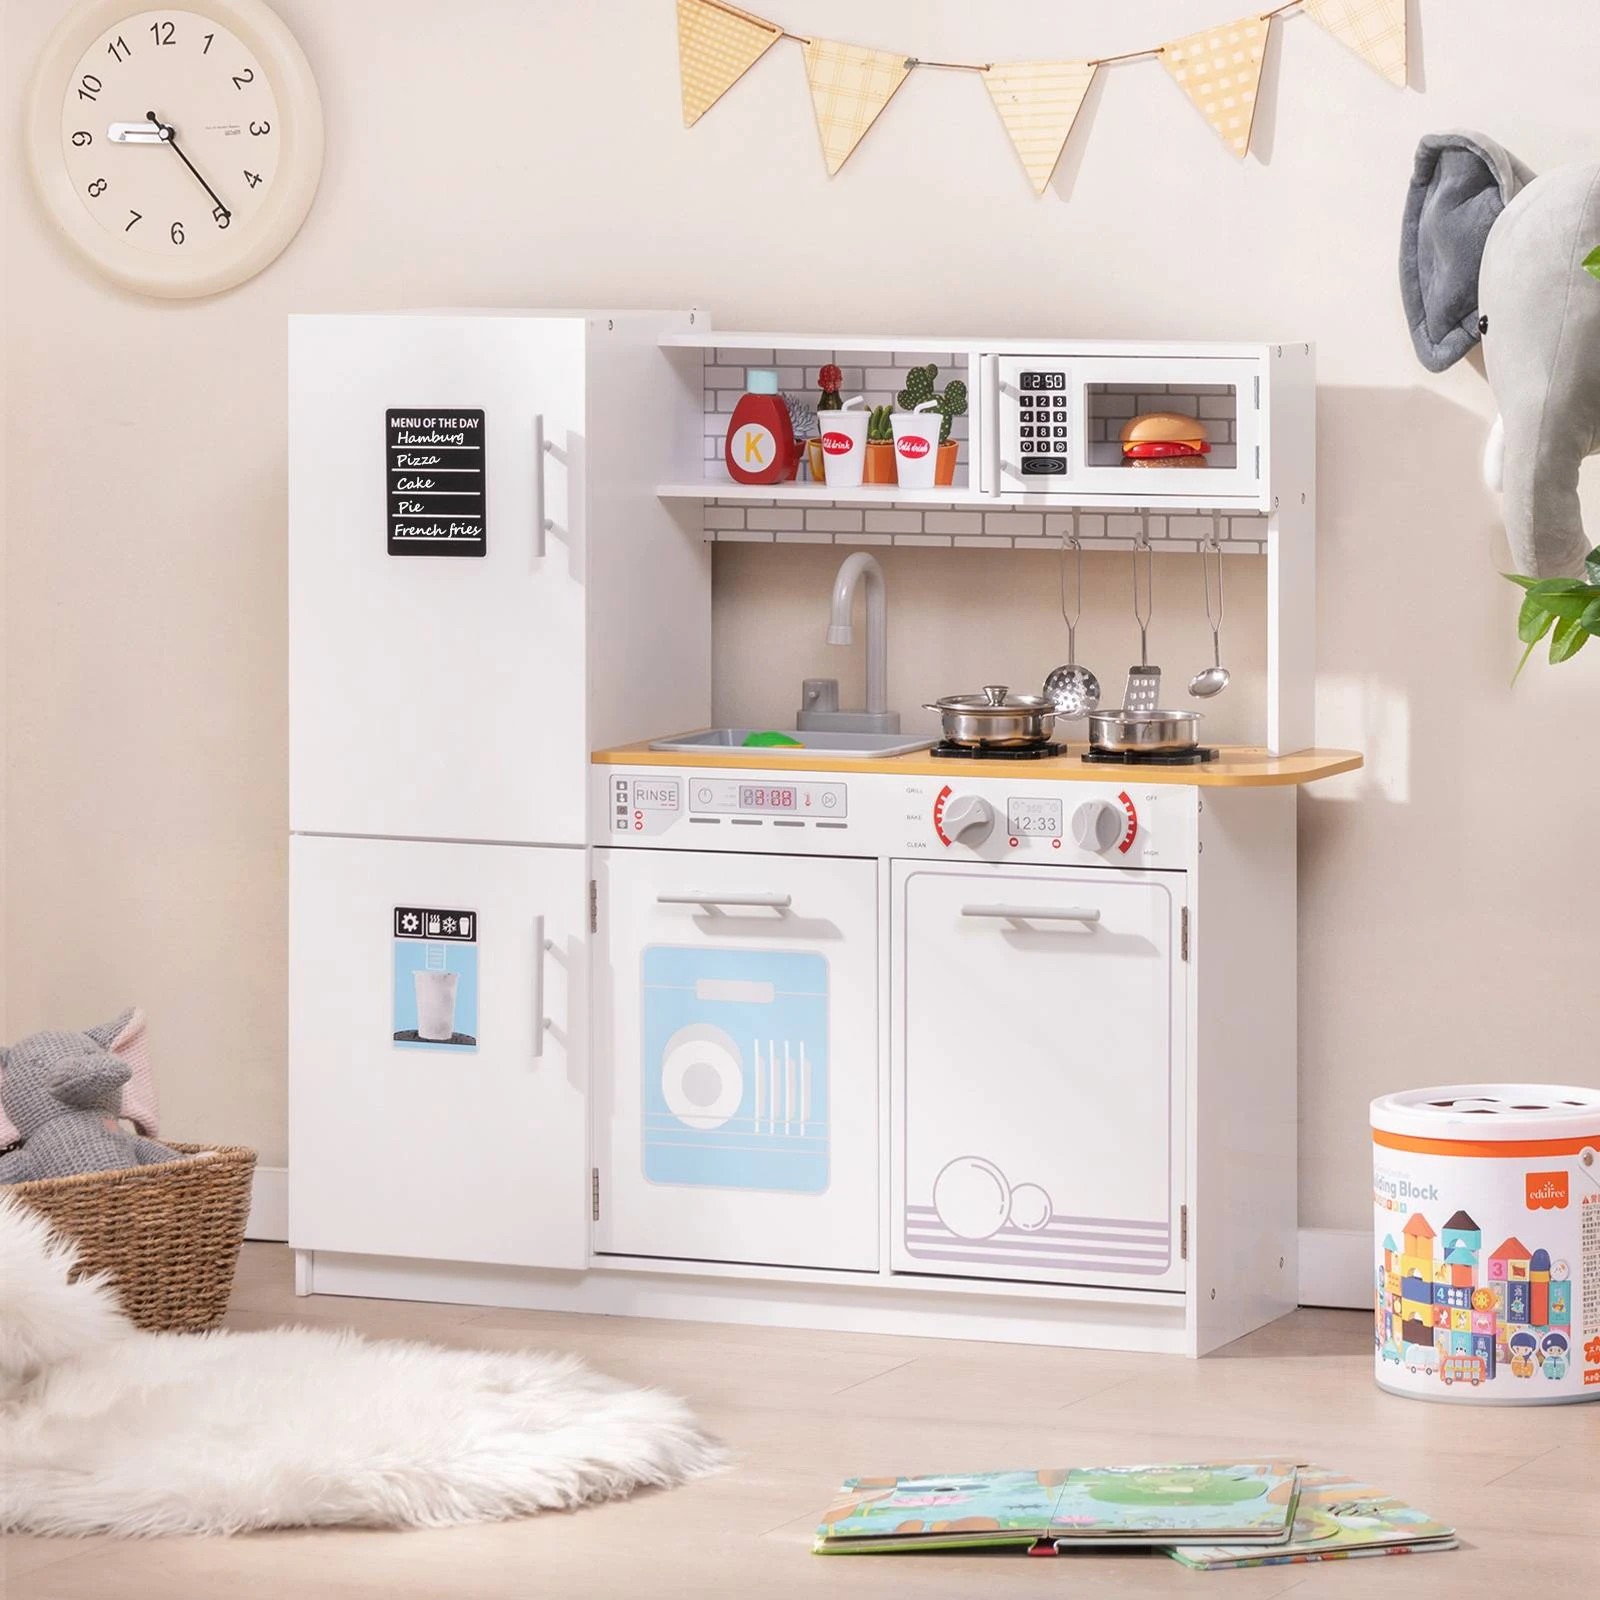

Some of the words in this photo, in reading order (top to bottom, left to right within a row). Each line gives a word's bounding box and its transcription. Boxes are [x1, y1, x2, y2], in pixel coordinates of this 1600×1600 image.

[150, 21, 176, 46] 12
[107, 36, 132, 63] 11
[202, 34, 214, 54] 1
[232, 68, 255, 90] 2
[78, 74, 102, 101] 10
[249, 121, 271, 136] 3
[71, 130, 93, 147] 9
[243, 170, 263, 189] 4
[87, 178, 107, 198] 8
[125, 210, 142, 232] 7
[212, 204, 231, 230] 5
[170, 222, 185, 245] 6
[1024, 398, 1030, 406] 1
[1040, 398, 1046, 406] 2
[1057, 398, 1063, 406] 3
[391, 418, 421, 428] MENU
[423, 418, 436, 428] OF
[438, 418, 457, 428] THE
[460, 418, 479, 428] DAY
[1024, 413, 1030, 421] 4
[1040, 413, 1046, 421] 5
[1057, 413, 1063, 421] 6
[397, 431, 464, 445] Hamburg
[1024, 428, 1030, 436] 7
[1040, 428, 1046, 436] 8
[1057, 428, 1063, 436] 9
[745, 431, 764, 464] K
[1040, 442, 1046, 451] 0
[397, 453, 440, 467] Pizza
[397, 477, 435, 490] Cake
[398, 500, 424, 514] Pie
[395, 524, 446, 536] French
[448, 522, 482, 538] fries
[636, 789, 676, 801] RINSE
[1014, 816, 1056, 831] 12:33
[1400, 1180, 1438, 1201] Block
[1492, 1262, 1503, 1277] 3
[1436, 1287, 1444, 1300] 4
